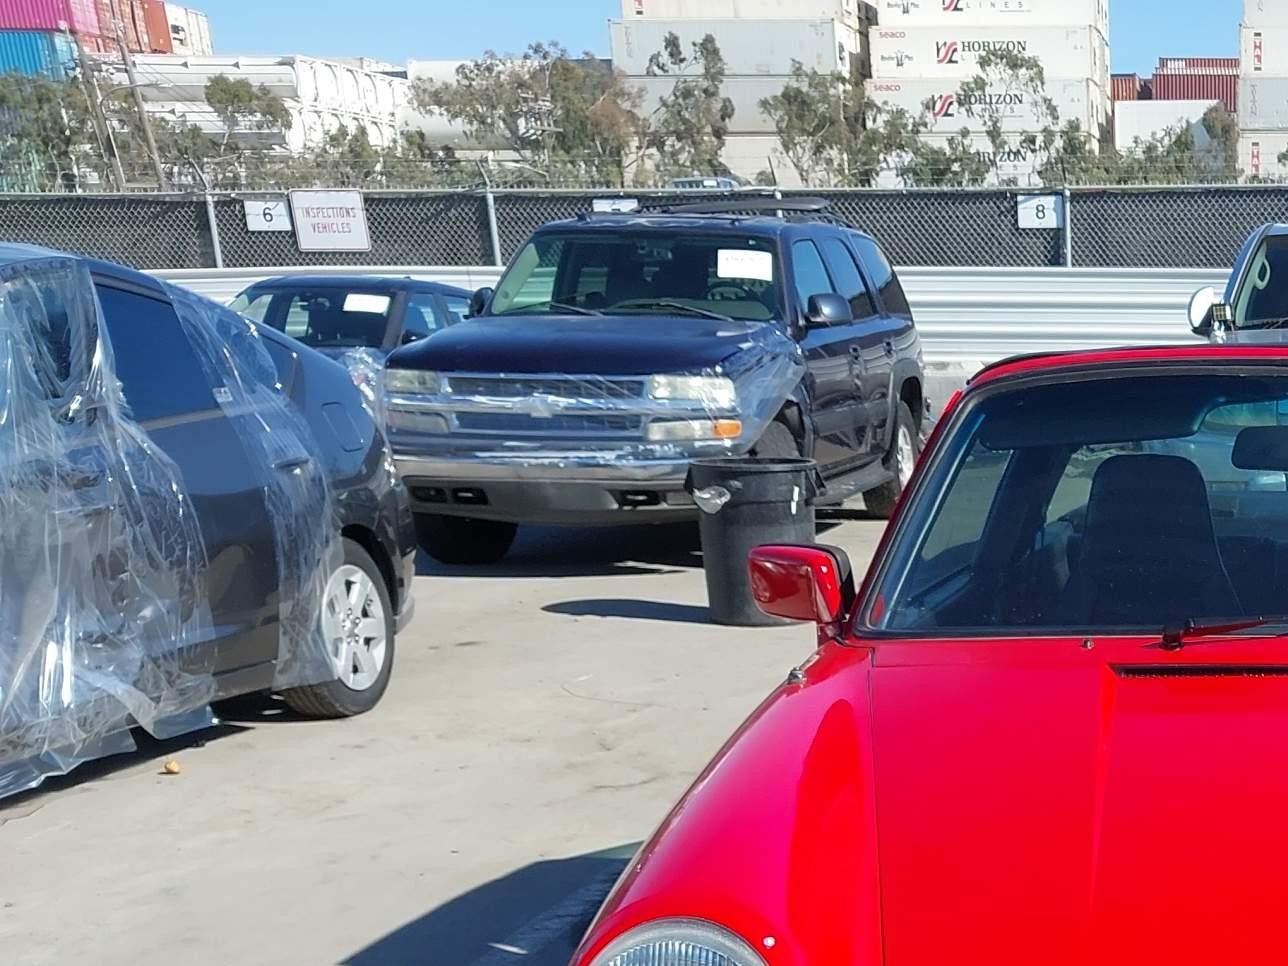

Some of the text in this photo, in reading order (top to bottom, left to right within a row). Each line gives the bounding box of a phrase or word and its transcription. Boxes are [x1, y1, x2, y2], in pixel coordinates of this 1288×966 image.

[966, 1, 1024, 9] LINES
[961, 40, 1027, 52] HORIZON
[262, 206, 274, 223] 6
[301, 207, 356, 218] INSPECTIONS
[1035, 203, 1046, 220] 8
[311, 222, 352, 233] VEHICLES
